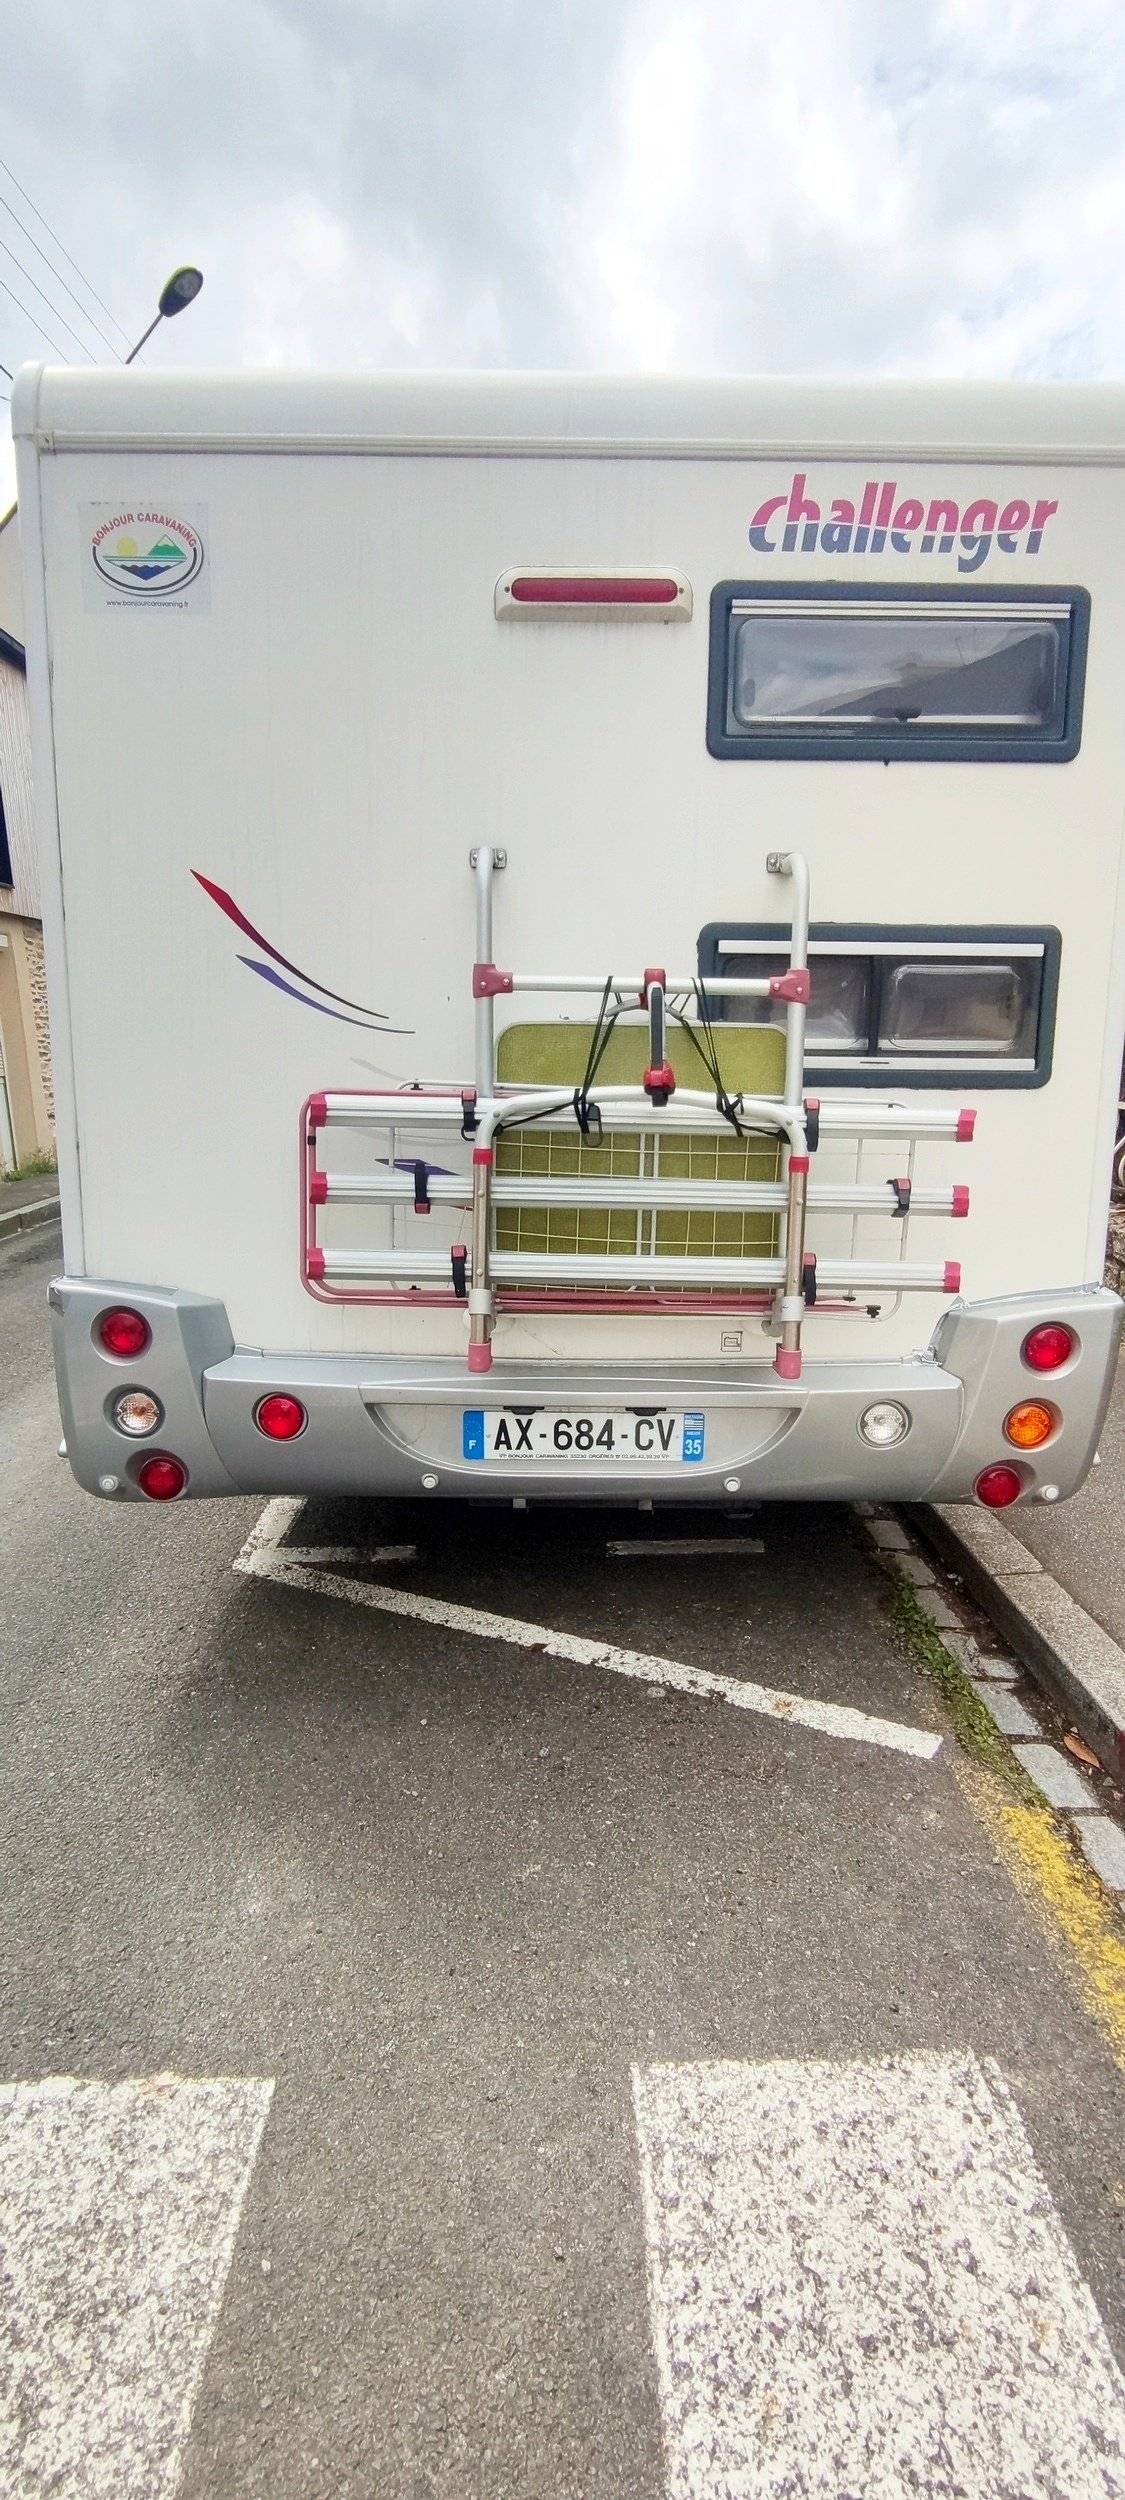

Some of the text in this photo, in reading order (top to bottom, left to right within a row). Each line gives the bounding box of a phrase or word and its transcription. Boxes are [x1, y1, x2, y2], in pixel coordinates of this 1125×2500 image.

[92, 512, 198, 548] BONJOUR CARAVANING
[748, 473, 1058, 573] challenger
[468, 1439, 477, 1450] F
[494, 1418, 675, 1451] AX-684-CV
[684, 1438, 702, 1454] 35
